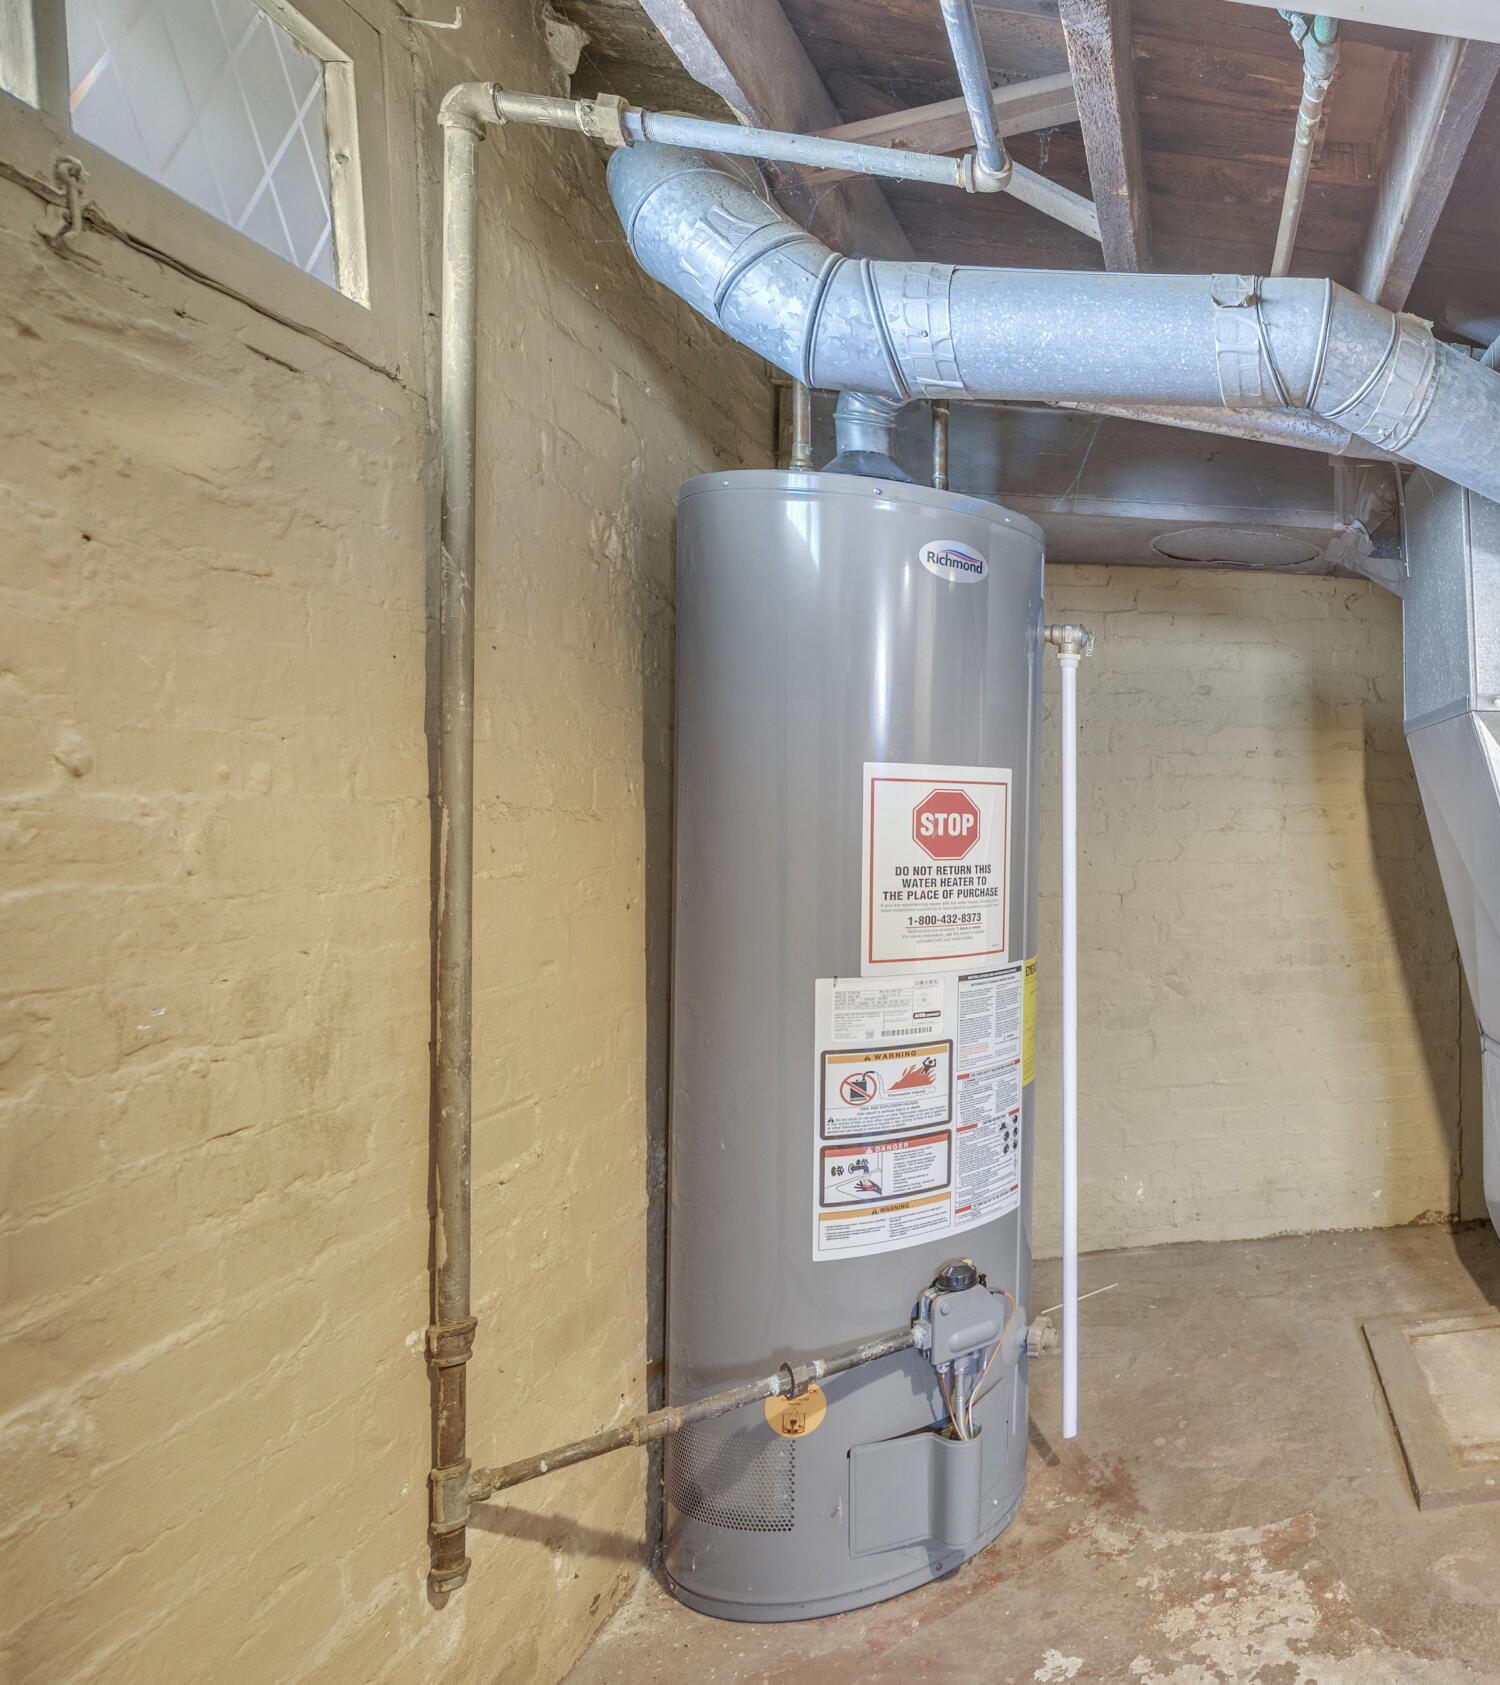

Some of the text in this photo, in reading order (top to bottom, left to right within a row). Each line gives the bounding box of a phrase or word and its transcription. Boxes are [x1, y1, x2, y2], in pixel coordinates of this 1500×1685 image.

[927, 551, 983, 575] Richmond
[920, 812, 974, 837] STOP
[895, 864, 992, 877] DO NOT RETURN THIS
[902, 876, 987, 888] WATER HEATER TO
[882, 887, 999, 901] THE PLACE OF PURCHASE
[908, 913, 982, 926] 1-800-432-8373
[874, 1050, 917, 1061] WARNING
[875, 1143, 909, 1153] DANGER
[879, 1203, 910, 1213] WARNING
